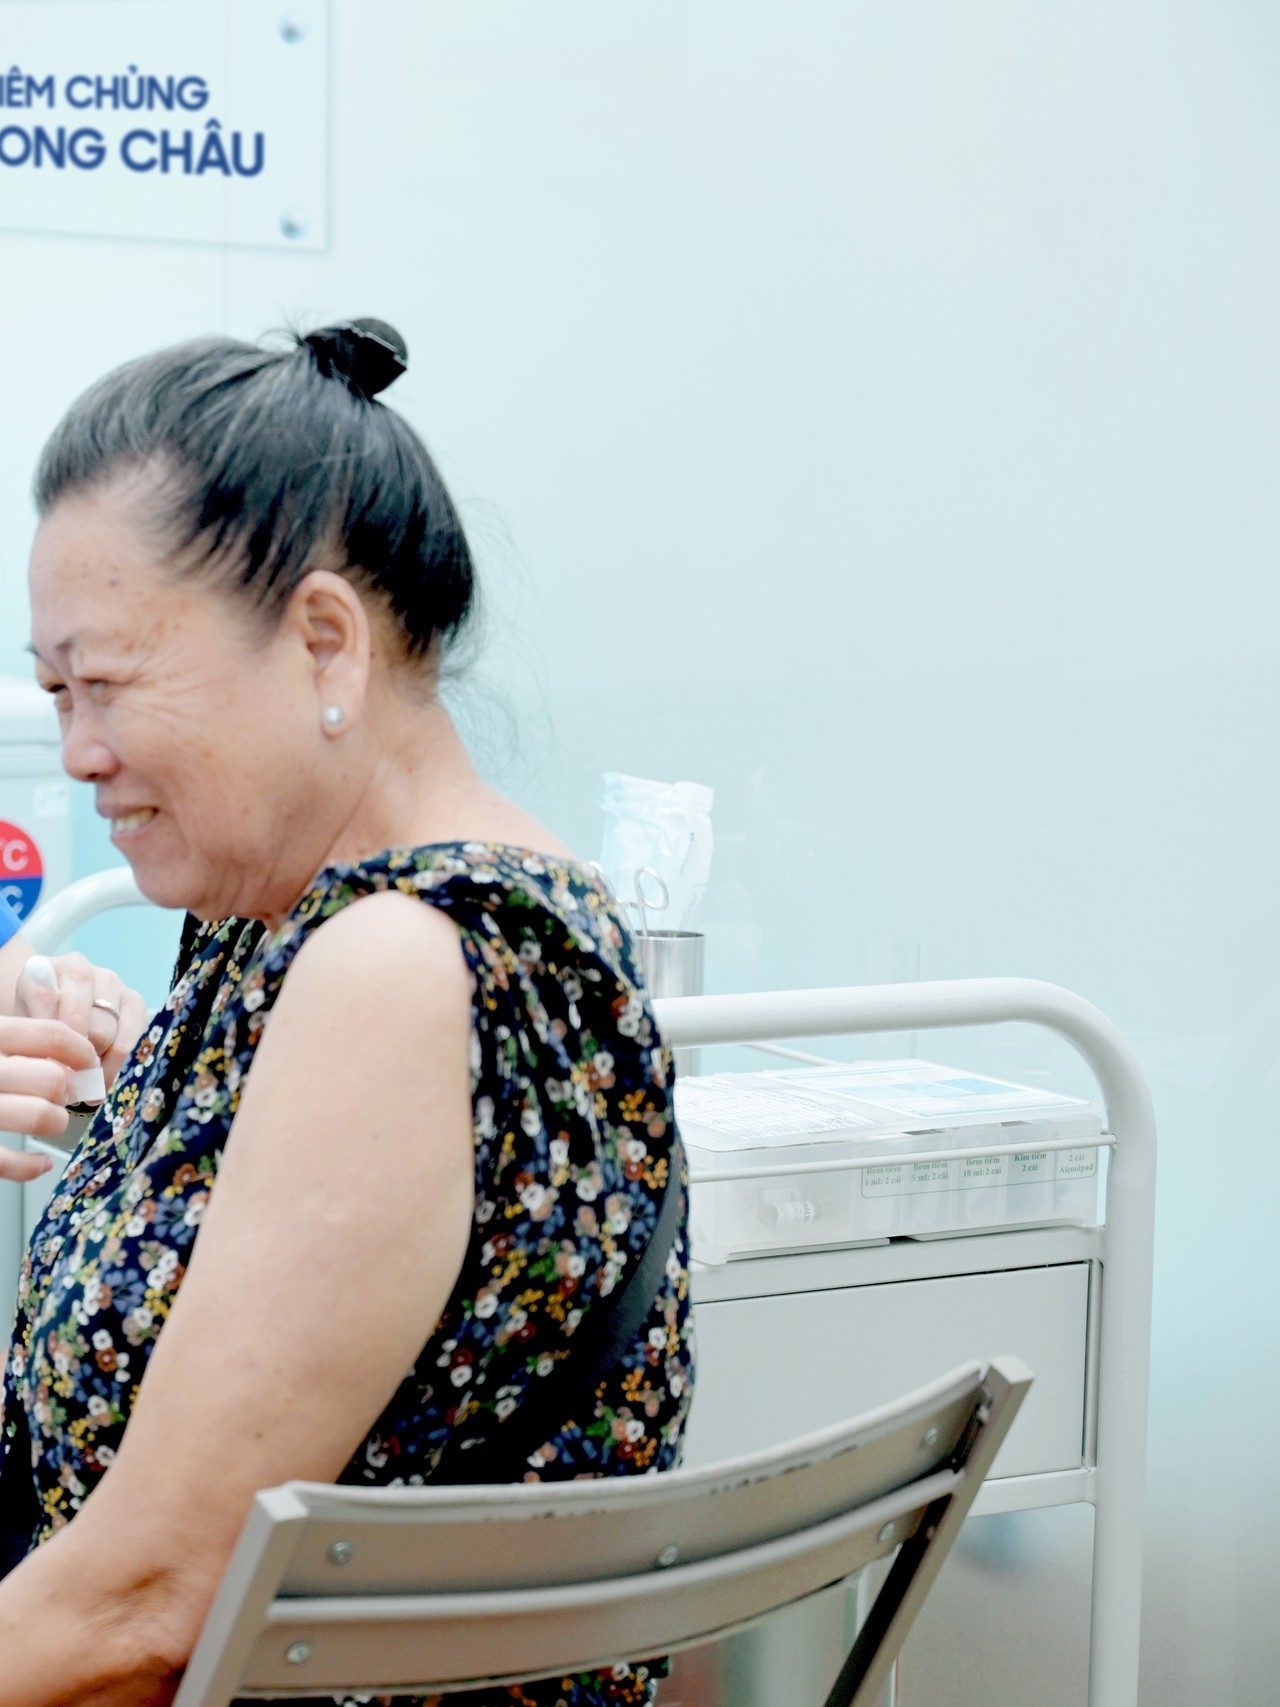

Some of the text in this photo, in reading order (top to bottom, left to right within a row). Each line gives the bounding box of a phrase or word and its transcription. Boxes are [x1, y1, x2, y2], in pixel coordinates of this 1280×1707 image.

[65, 64, 208, 111] CHỦNG
[120, 119, 265, 177] CHÂU
[1014, 1153, 1030, 1162] Kim
[1075, 1153, 1085, 1162] cái
[963, 1169, 971, 1177] 10
[991, 1167, 1002, 1175] cái
[1028, 1163, 1039, 1172] cái
[891, 1176, 902, 1184] cái
[938, 1171, 949, 1180] cái
